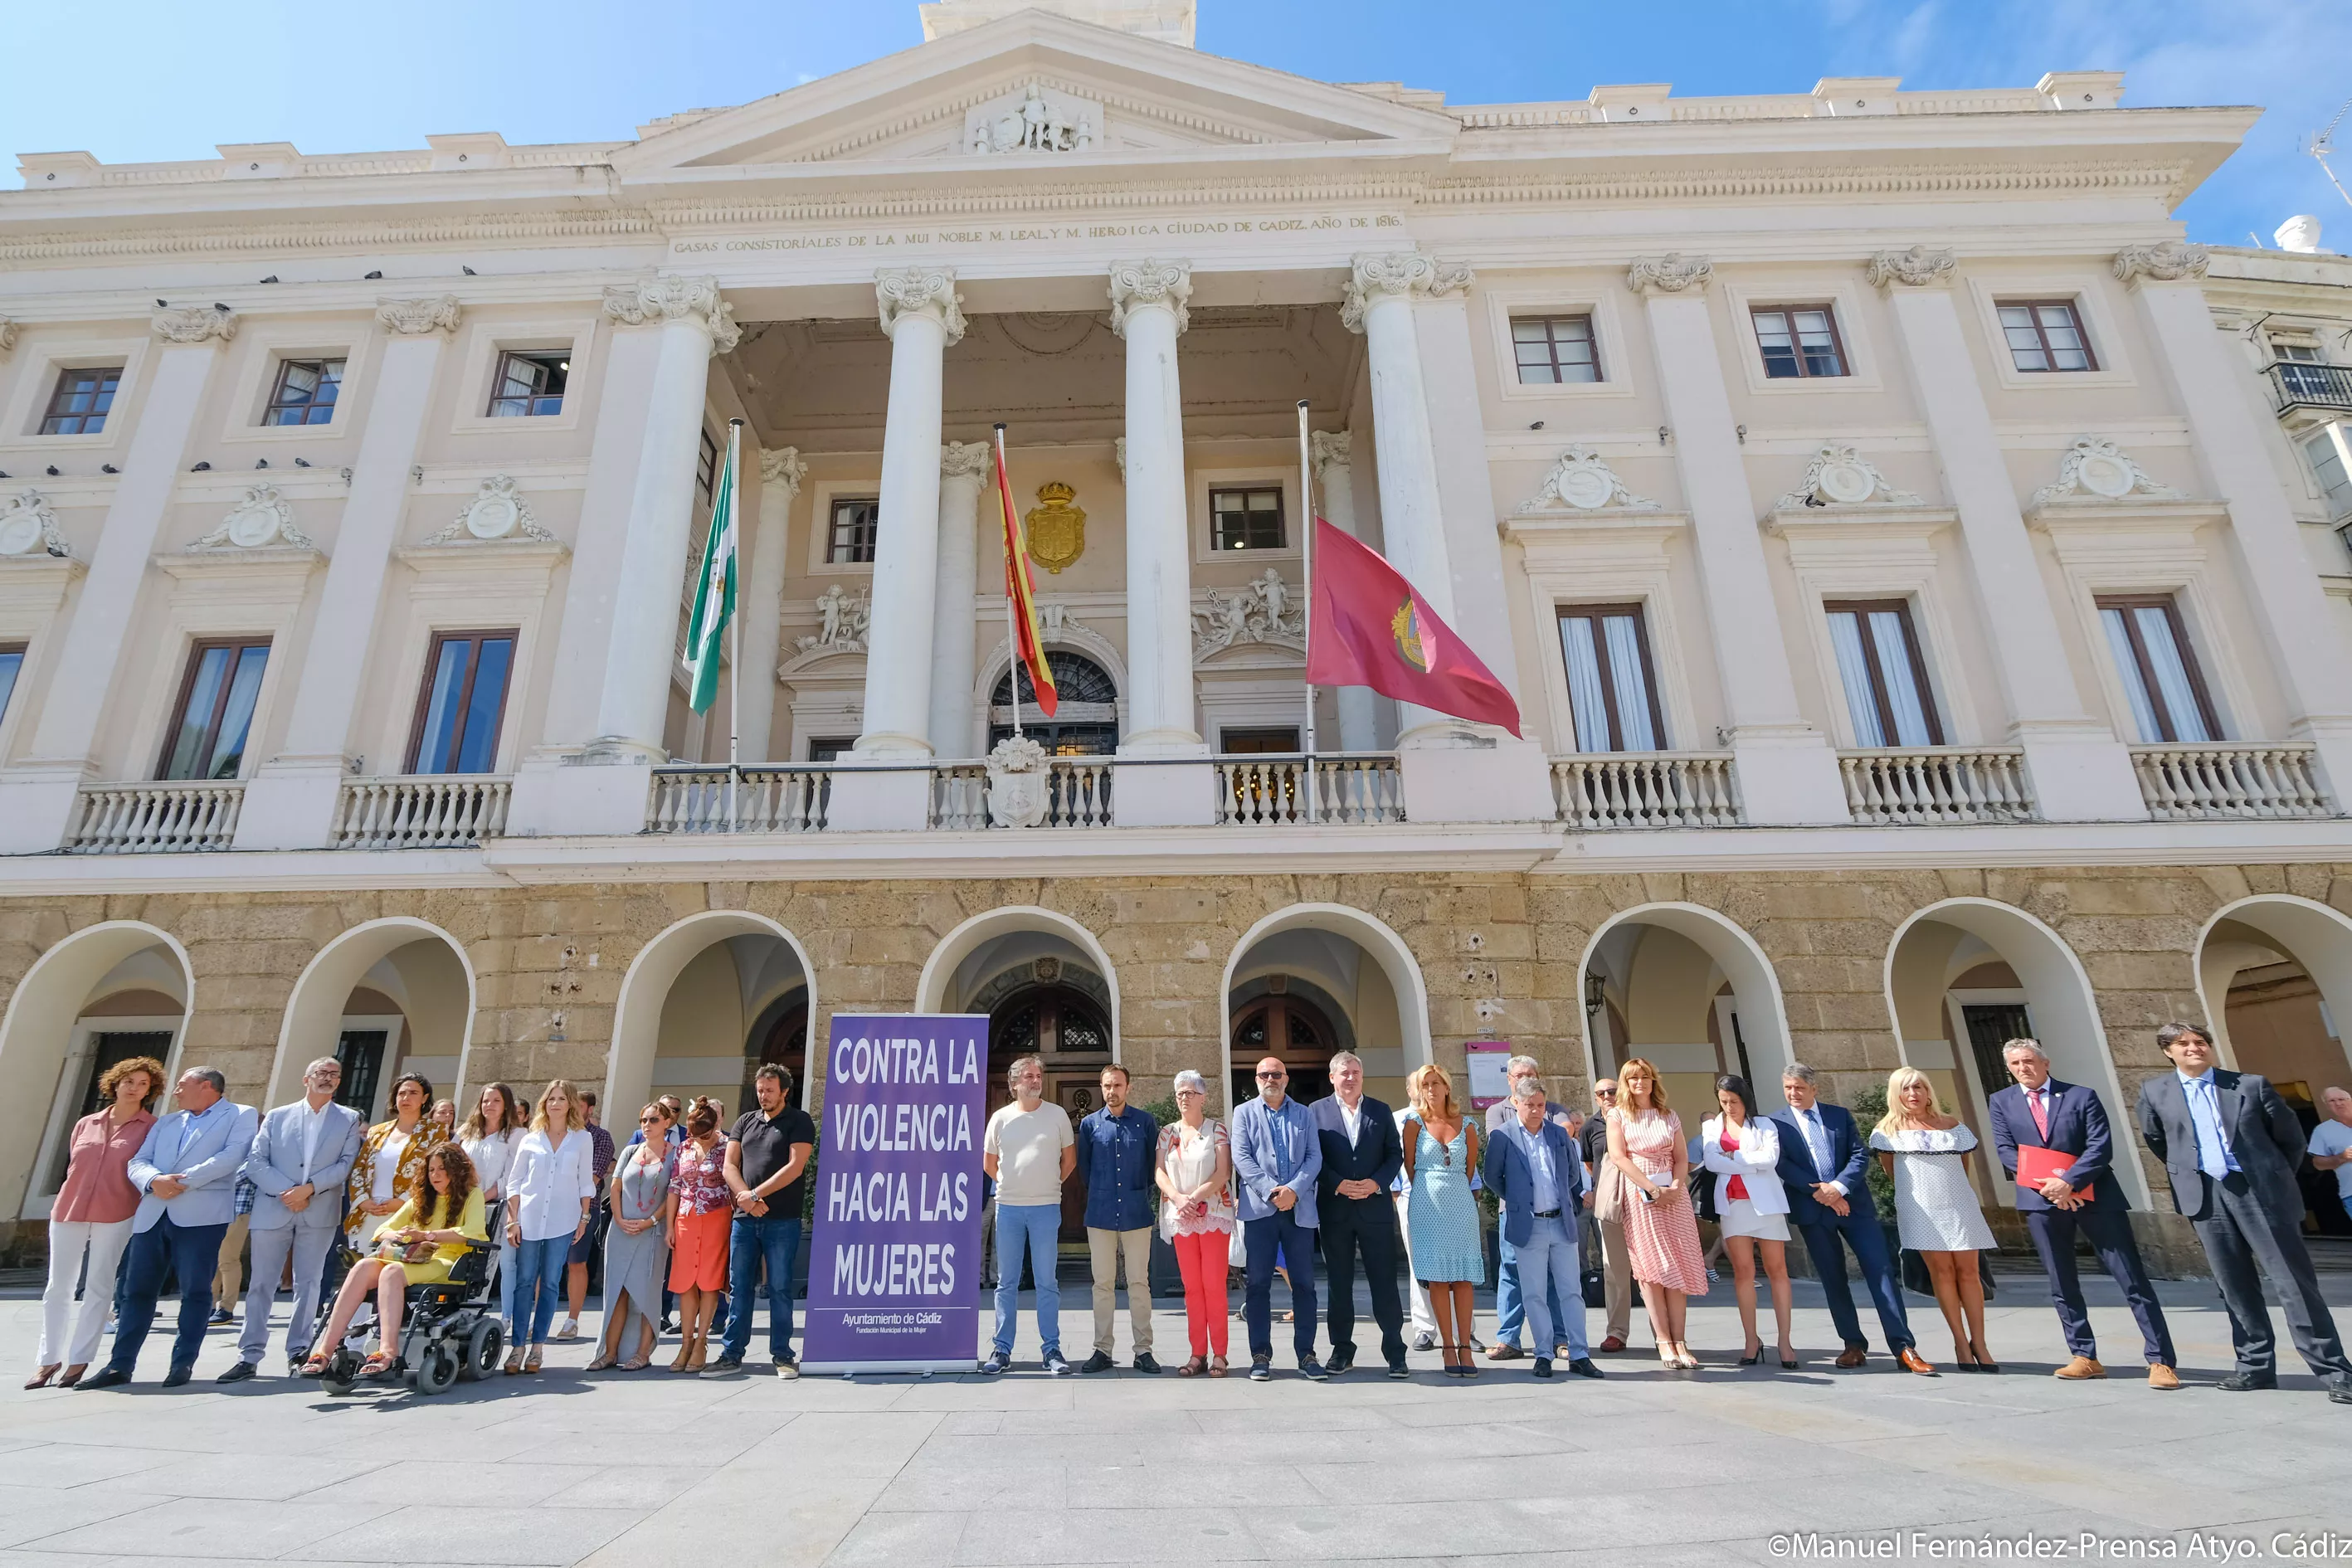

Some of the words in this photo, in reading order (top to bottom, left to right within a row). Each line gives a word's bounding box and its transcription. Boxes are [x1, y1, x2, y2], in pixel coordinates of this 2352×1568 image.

[848, 236, 867, 246] DE
[875, 234, 896, 246] LA
[904, 233, 929, 244] MUI
[938, 231, 982, 243] NOBLE
[989, 230, 1005, 241] M.
[1066, 227, 1082, 238] M.
[1166, 222, 1228, 234] CIUDAD
[1234, 222, 1252, 232] DE
[1310, 216, 1342, 229] AÑO
[1350, 217, 1368, 228] DE
[835, 1037, 939, 1084] CONTRA
[947, 1039, 979, 1084] LA
[835, 1103, 972, 1152] VIOLENCIA
[828, 1171, 911, 1222] HACIA
[919, 1171, 969, 1222] LAS
[833, 1243, 956, 1296] MUJERES
[842, 1312, 902, 1327] Ayuntamiento
[903, 1312, 914, 1324] de
[916, 1312, 942, 1324] Cádiz
